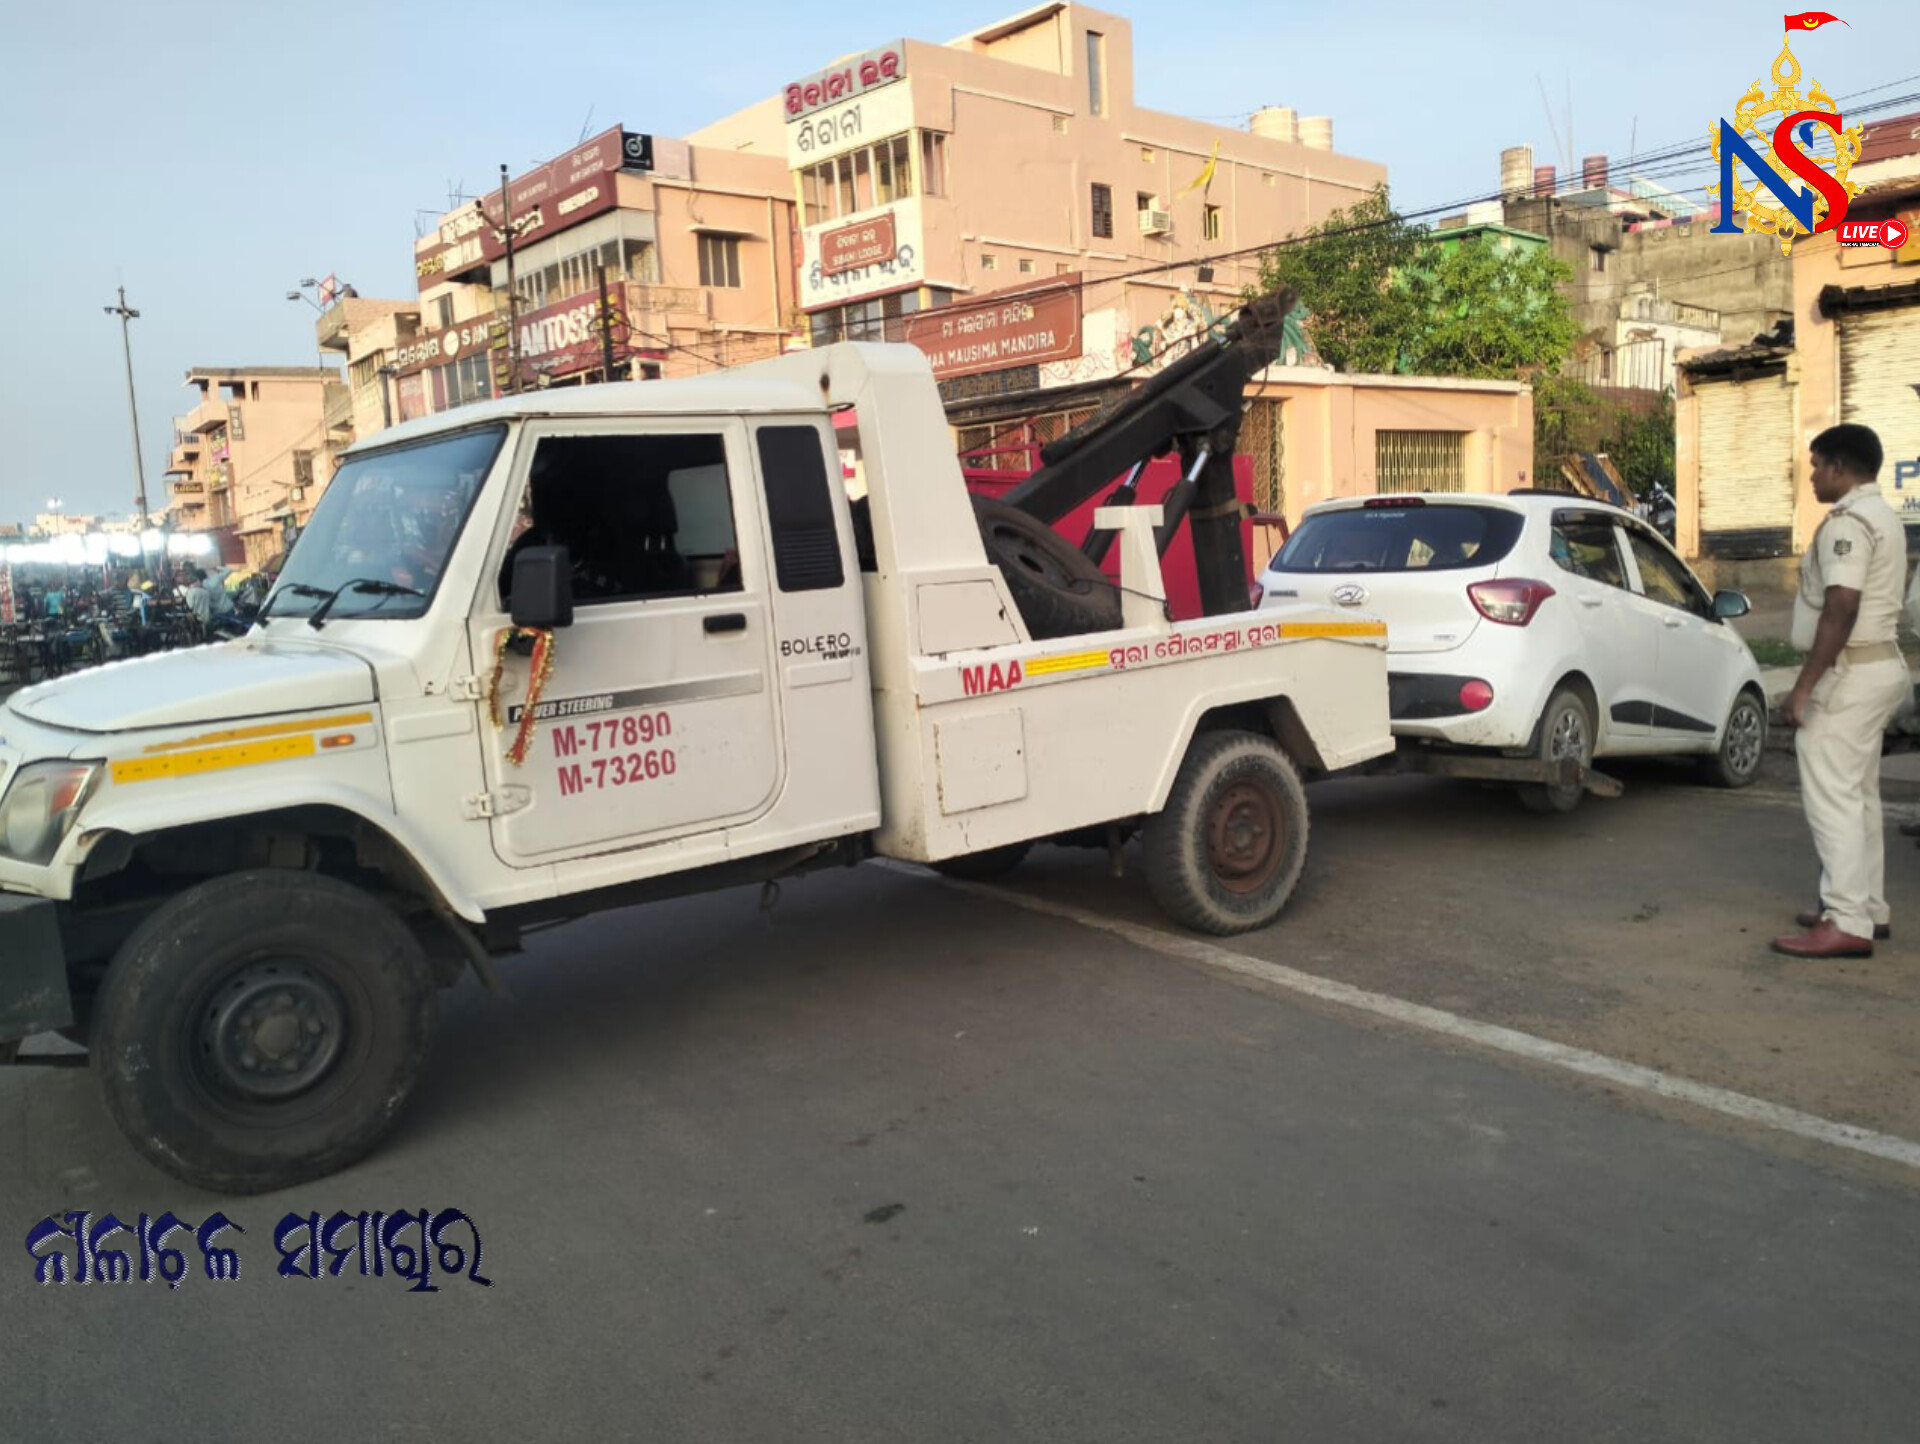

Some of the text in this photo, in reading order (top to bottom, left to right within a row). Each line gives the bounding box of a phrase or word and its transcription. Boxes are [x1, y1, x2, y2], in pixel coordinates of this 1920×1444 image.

[948, 341, 998, 366] MAUSIMA
[1001, 330, 1055, 356] MANDIRA
[781, 632, 851, 657] BOLERO
[1109, 644, 1148, 669] ପୁରୀ
[962, 659, 1022, 696] MAA
[558, 695, 614, 716] STEERING
[551, 711, 672, 758] M-77890
[557, 749, 677, 797] M-73260
